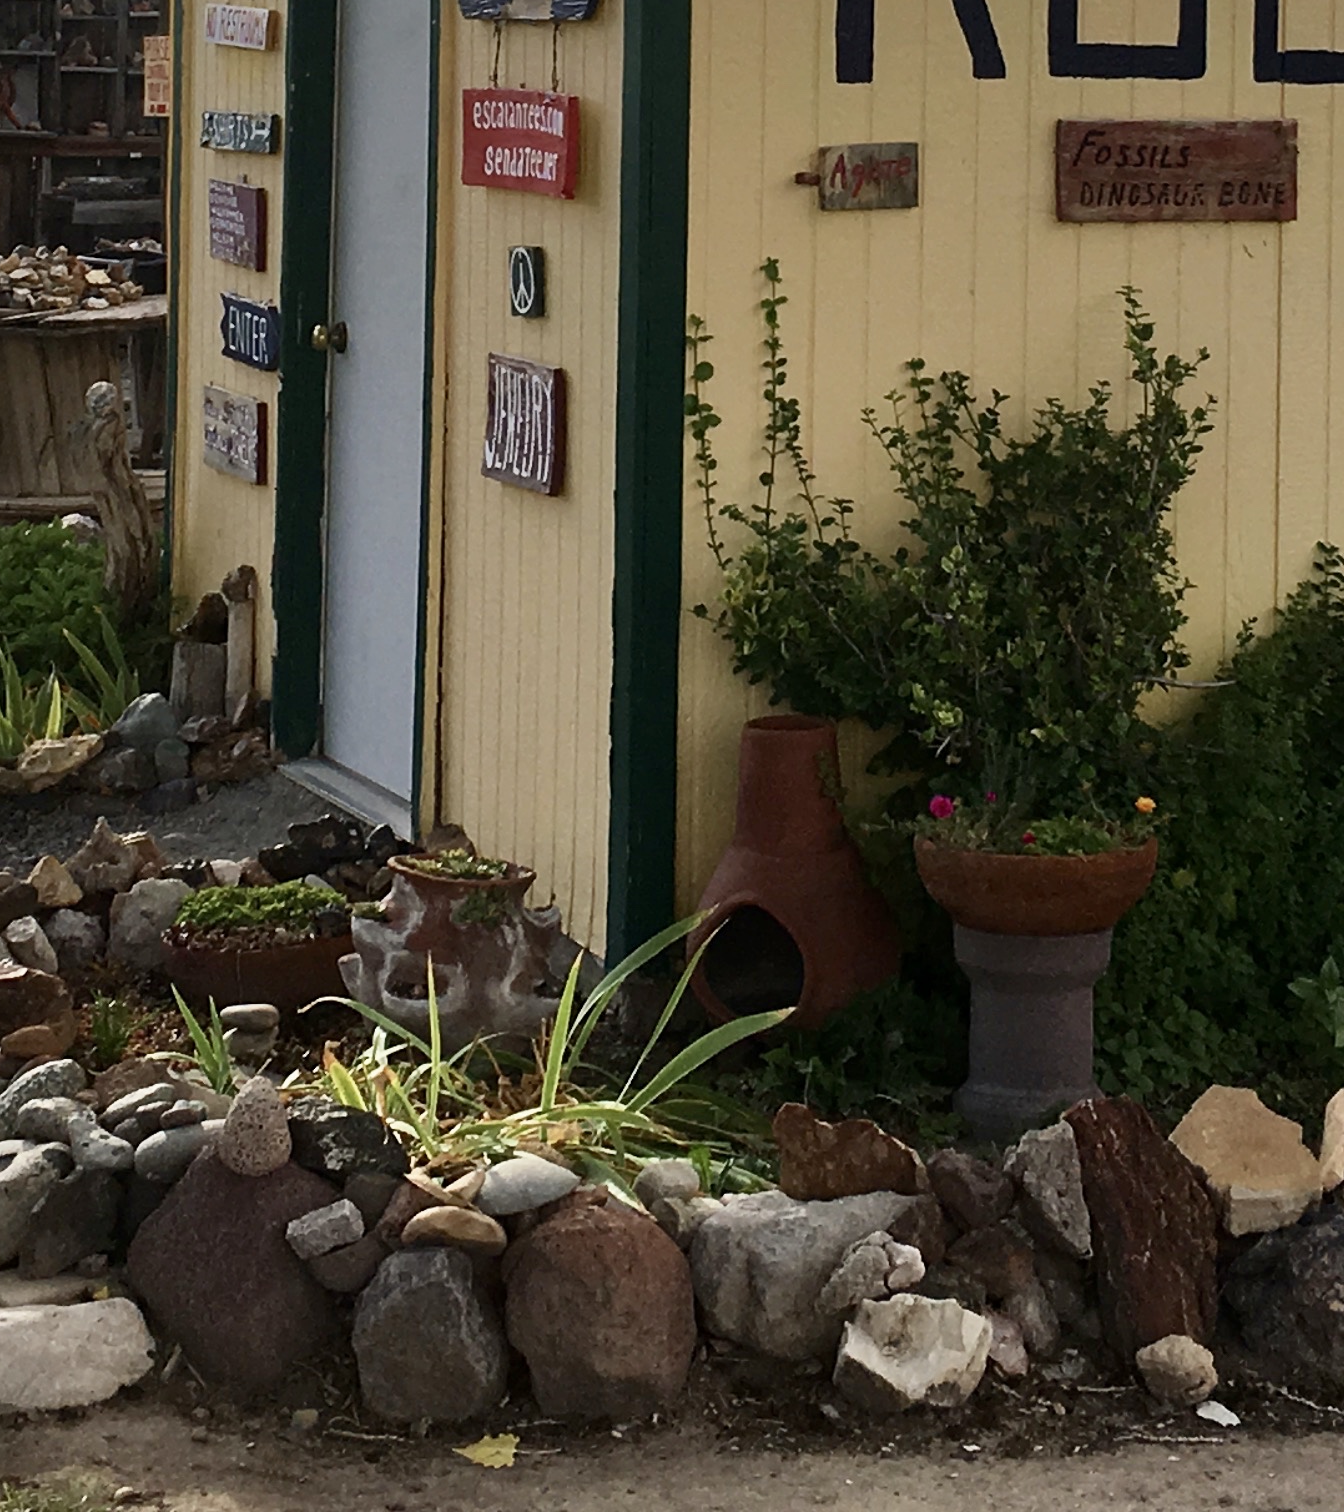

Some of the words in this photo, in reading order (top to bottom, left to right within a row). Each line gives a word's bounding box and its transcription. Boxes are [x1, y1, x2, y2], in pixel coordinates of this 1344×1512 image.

[1072, 128, 1191, 168] FOSSILS
[1217, 182, 1287, 207] BONE
[228, 306, 269, 365] ENTER
[484, 364, 554, 483] JEWELRY
